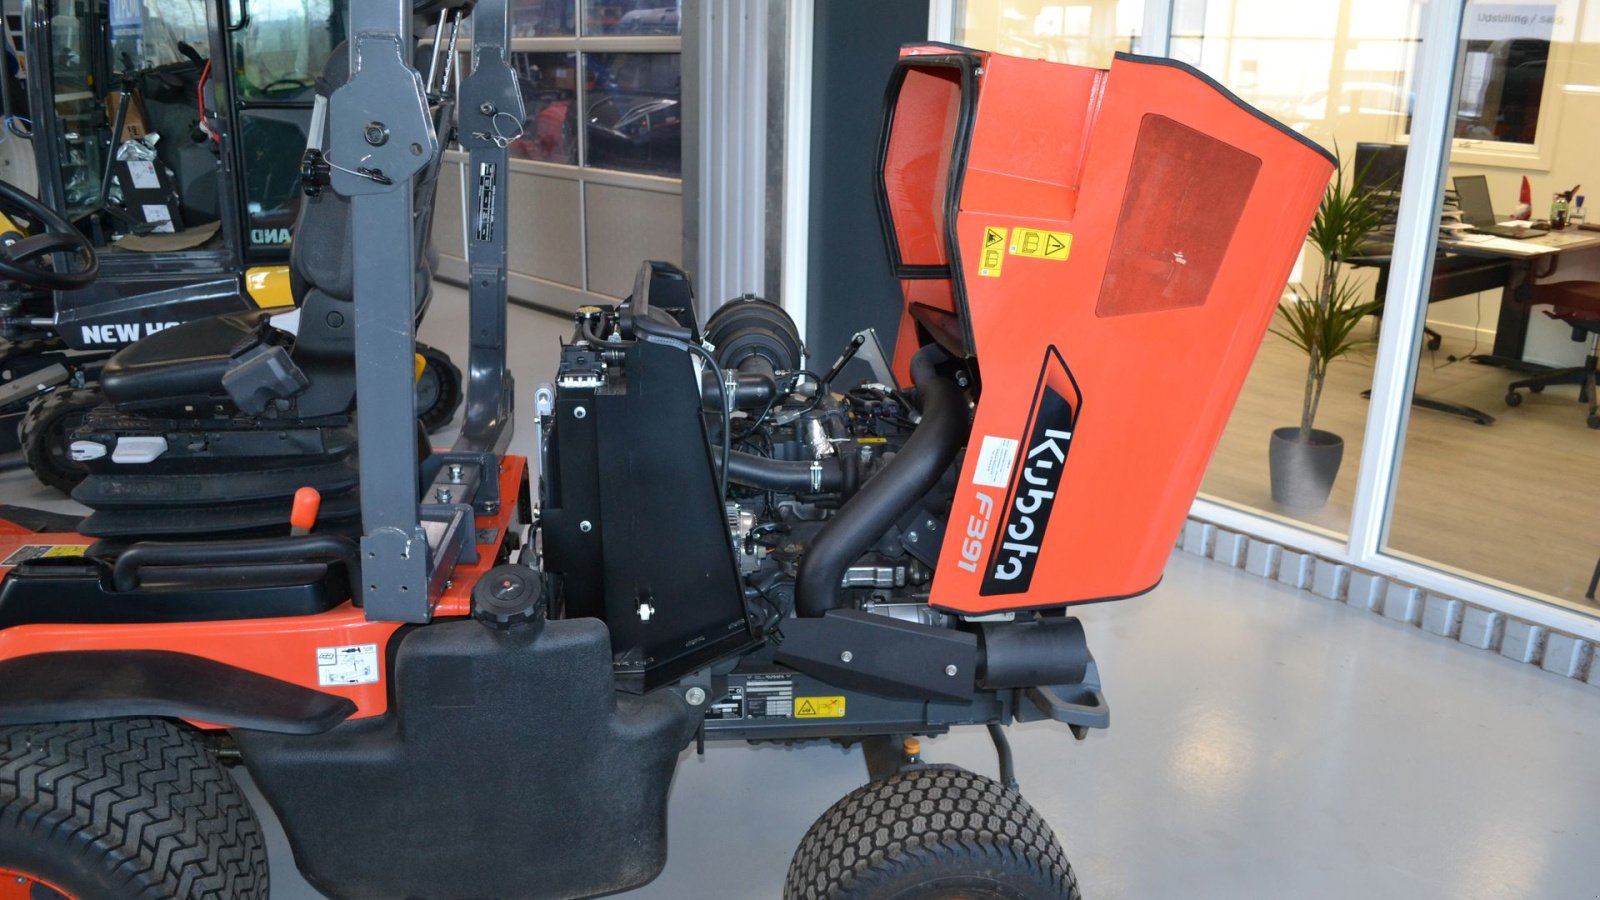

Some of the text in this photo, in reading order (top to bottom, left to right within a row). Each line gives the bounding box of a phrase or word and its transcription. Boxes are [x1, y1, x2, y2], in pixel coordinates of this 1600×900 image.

[1477, 13, 1528, 25] Udstilling
[81, 323, 140, 344] NEW
[994, 429, 1072, 580] Kubota
[957, 492, 994, 573] F391
